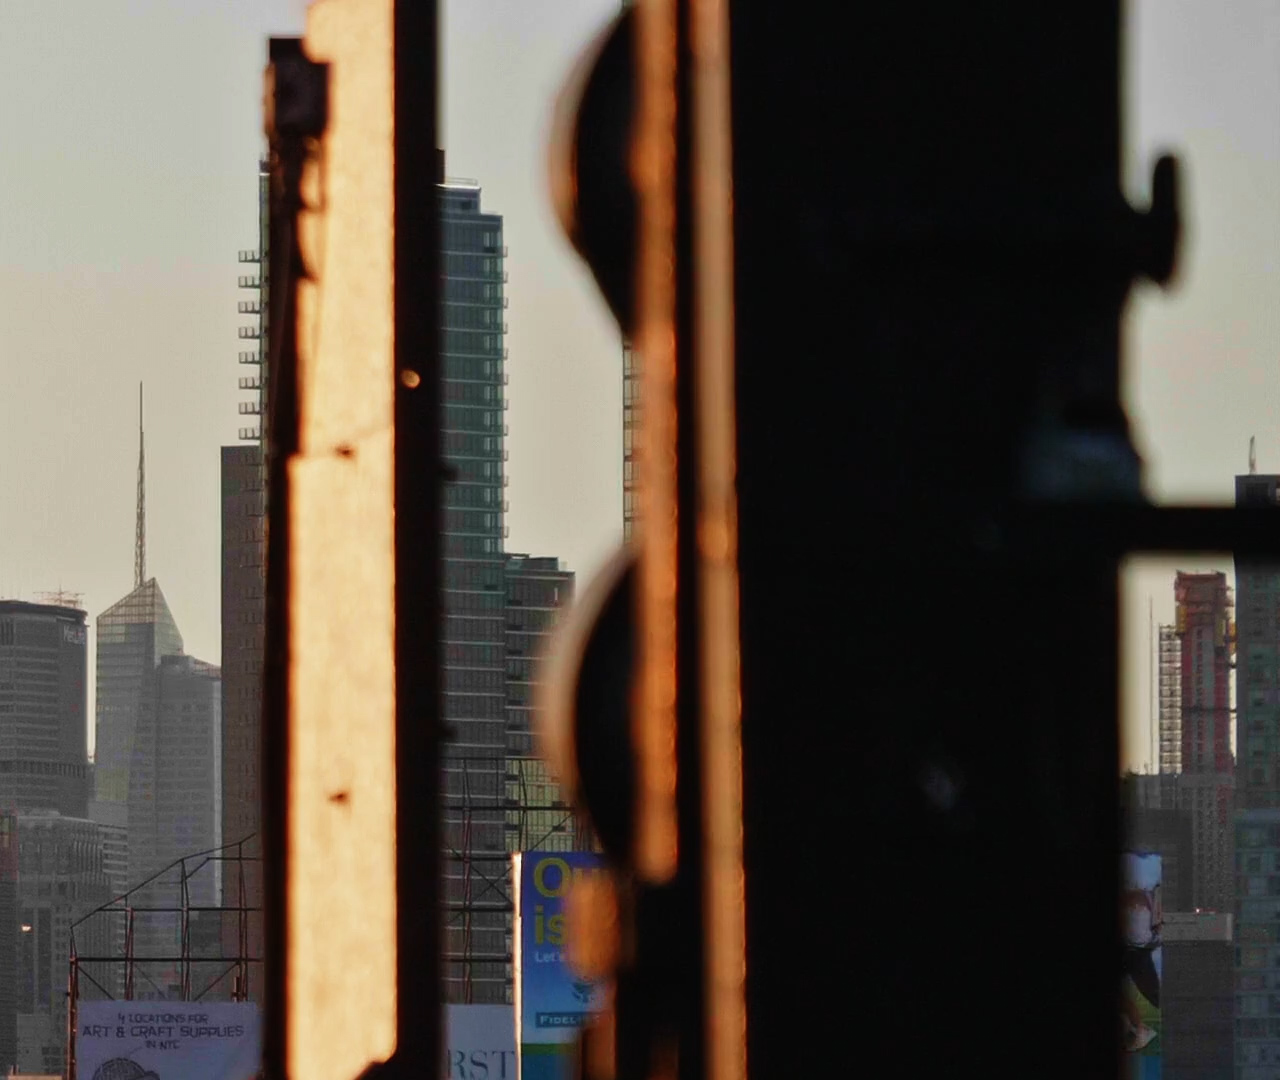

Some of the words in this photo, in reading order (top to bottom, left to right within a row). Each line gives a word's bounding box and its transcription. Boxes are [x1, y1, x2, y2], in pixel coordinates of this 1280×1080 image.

[129, 1013, 187, 1023] LOCATIONS
[188, 1013, 208, 1023] FOR
[82, 1026, 111, 1038] ART
[115, 1027, 126, 1039] &
[130, 1025, 176, 1038] CRAFT
[180, 1025, 245, 1038] SUPPLIES
[145, 1040, 157, 1048] IN
